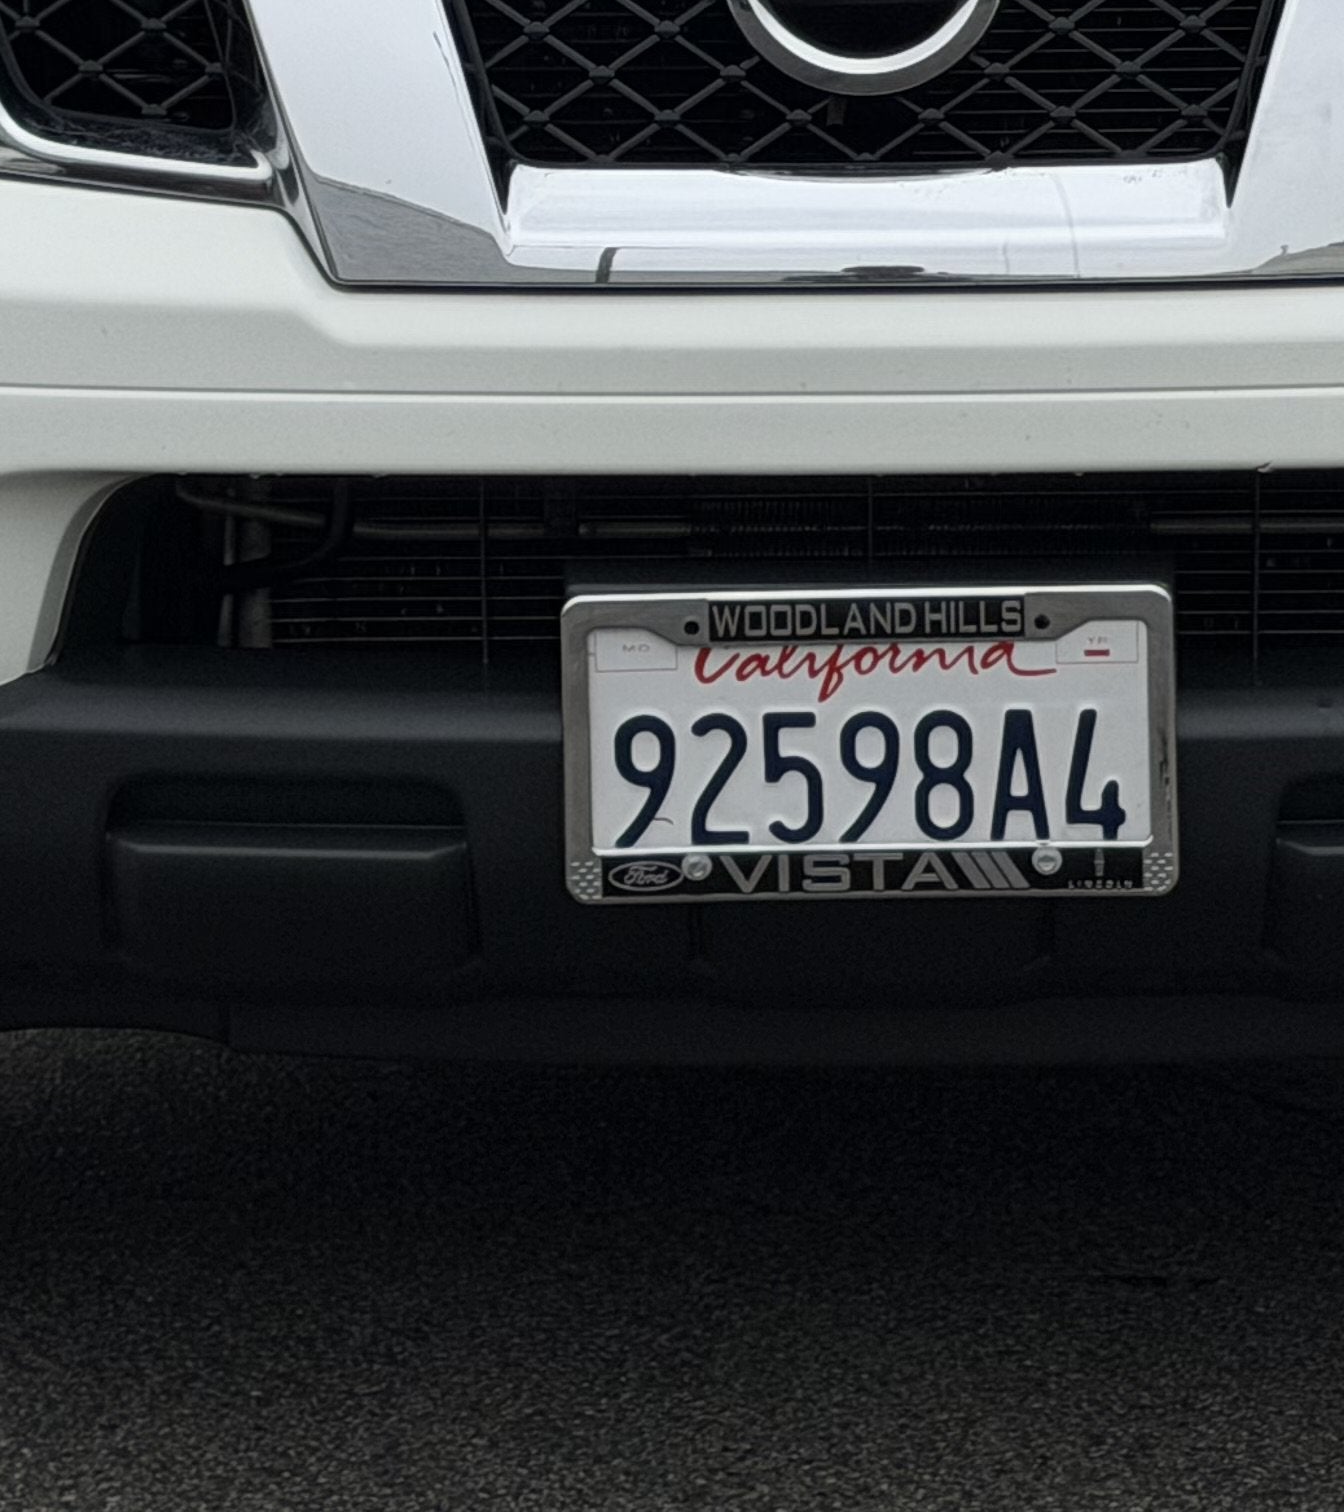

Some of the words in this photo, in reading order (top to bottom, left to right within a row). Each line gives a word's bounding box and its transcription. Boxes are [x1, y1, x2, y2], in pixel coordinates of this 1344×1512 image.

[711, 601, 917, 638] WOODLAND
[923, 599, 1022, 634] HILLS
[694, 641, 1057, 703] California
[613, 707, 1127, 849] 92598A4
[623, 863, 669, 886] Ford
[719, 851, 961, 894] VISTA
